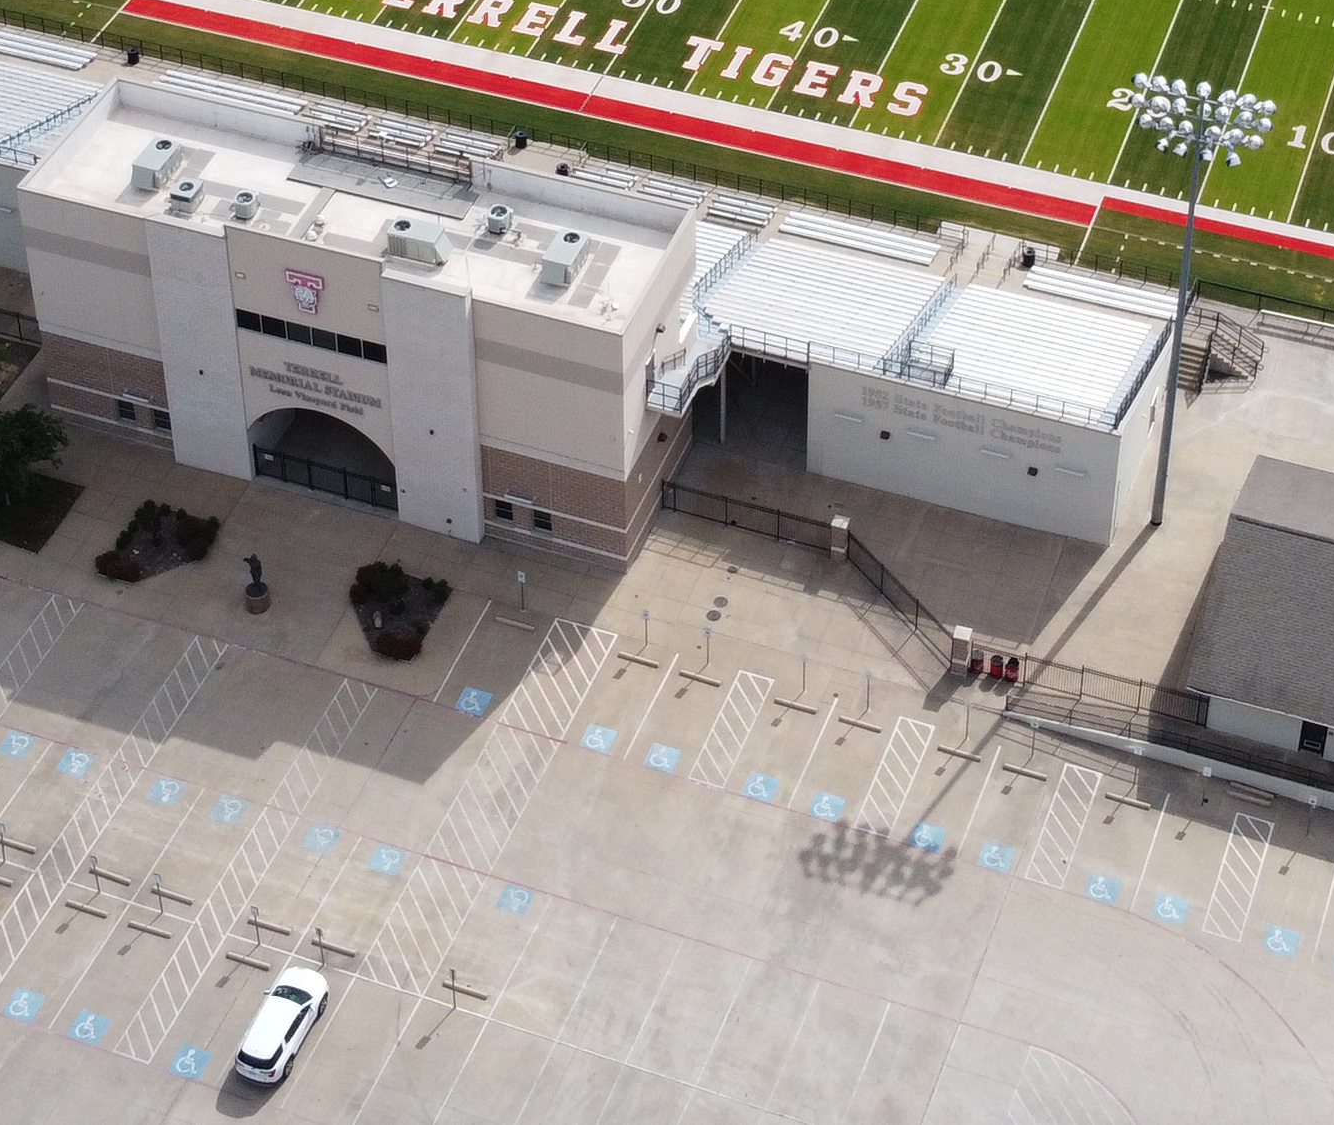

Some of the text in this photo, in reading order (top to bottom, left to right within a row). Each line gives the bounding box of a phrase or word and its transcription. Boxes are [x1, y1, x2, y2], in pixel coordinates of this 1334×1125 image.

[778, 20, 839, 48] 40
[681, 35, 930, 117] TIGERS
[939, 53, 1002, 82] 30
[249, 365, 382, 409] MEMORIAL STADIUM
[284, 360, 343, 386] TERRELL
